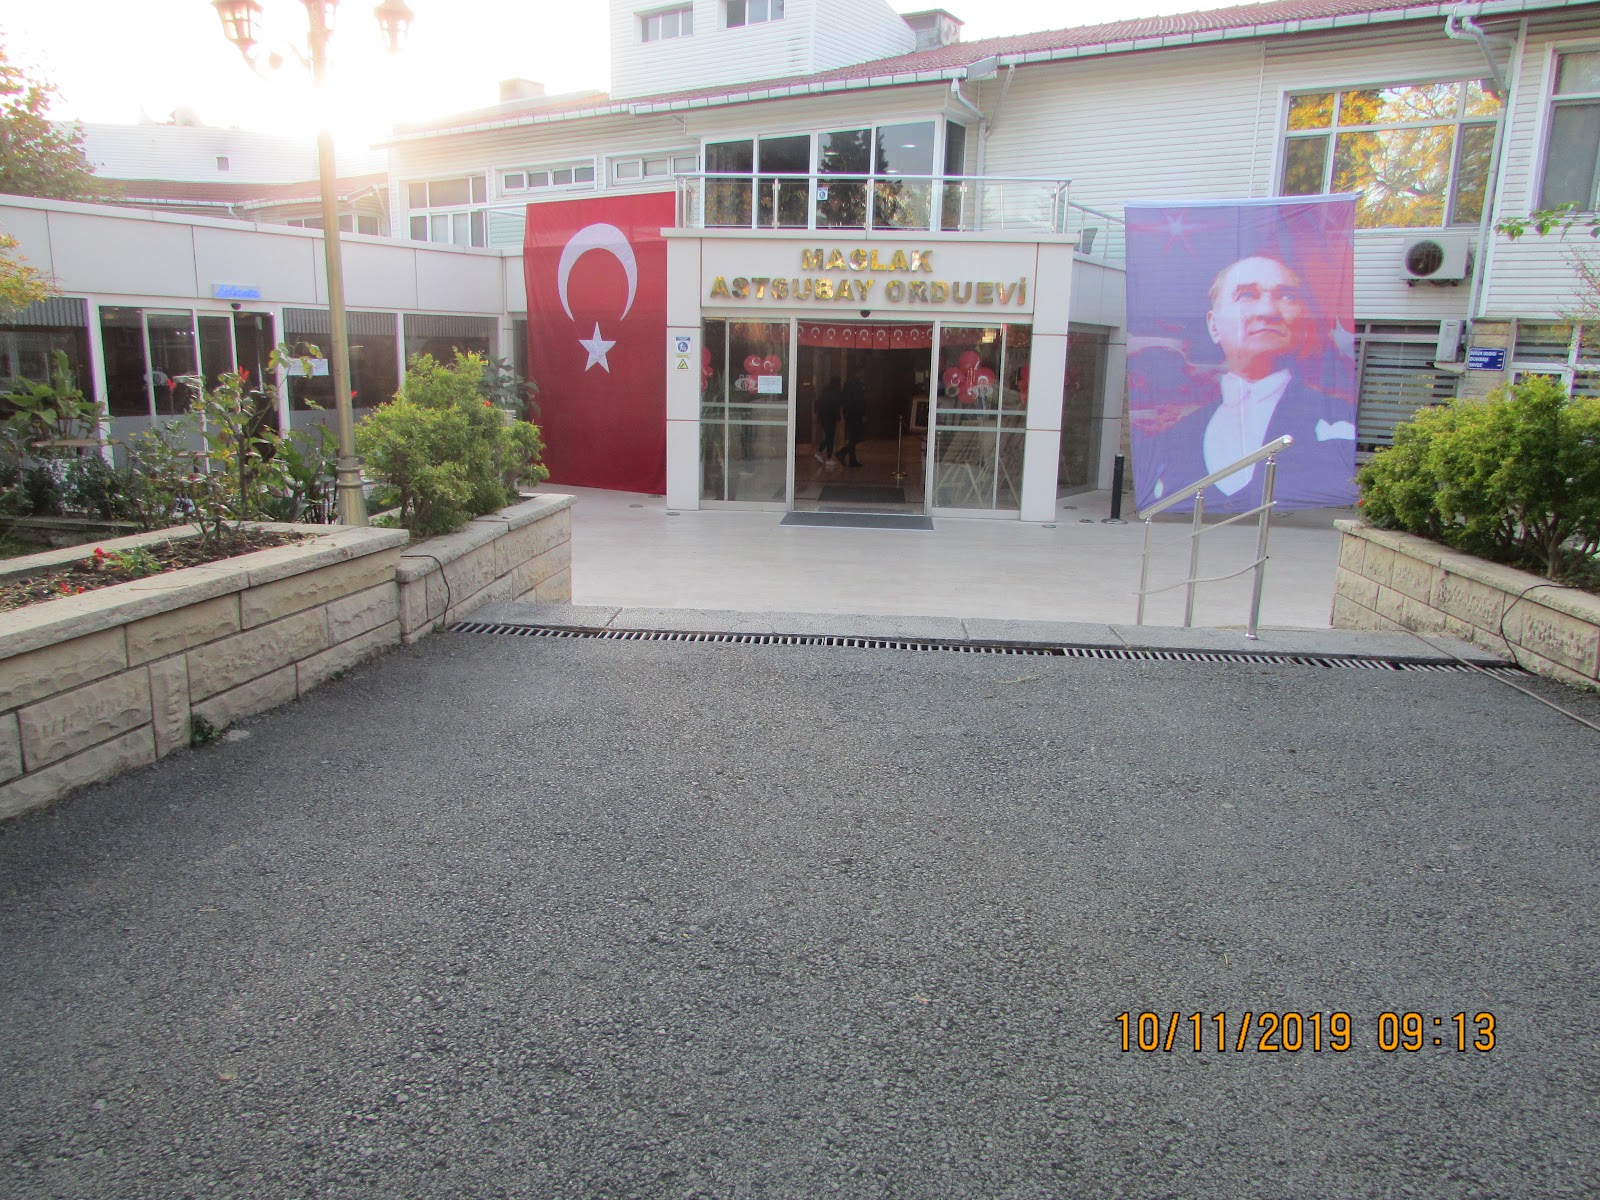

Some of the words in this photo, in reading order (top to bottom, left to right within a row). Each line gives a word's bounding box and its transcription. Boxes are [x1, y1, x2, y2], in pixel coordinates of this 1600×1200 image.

[801, 248, 934, 272] MASLAK
[709, 276, 875, 301] ASTSUBAY
[885, 277, 1027, 305] ORDUEVİ
